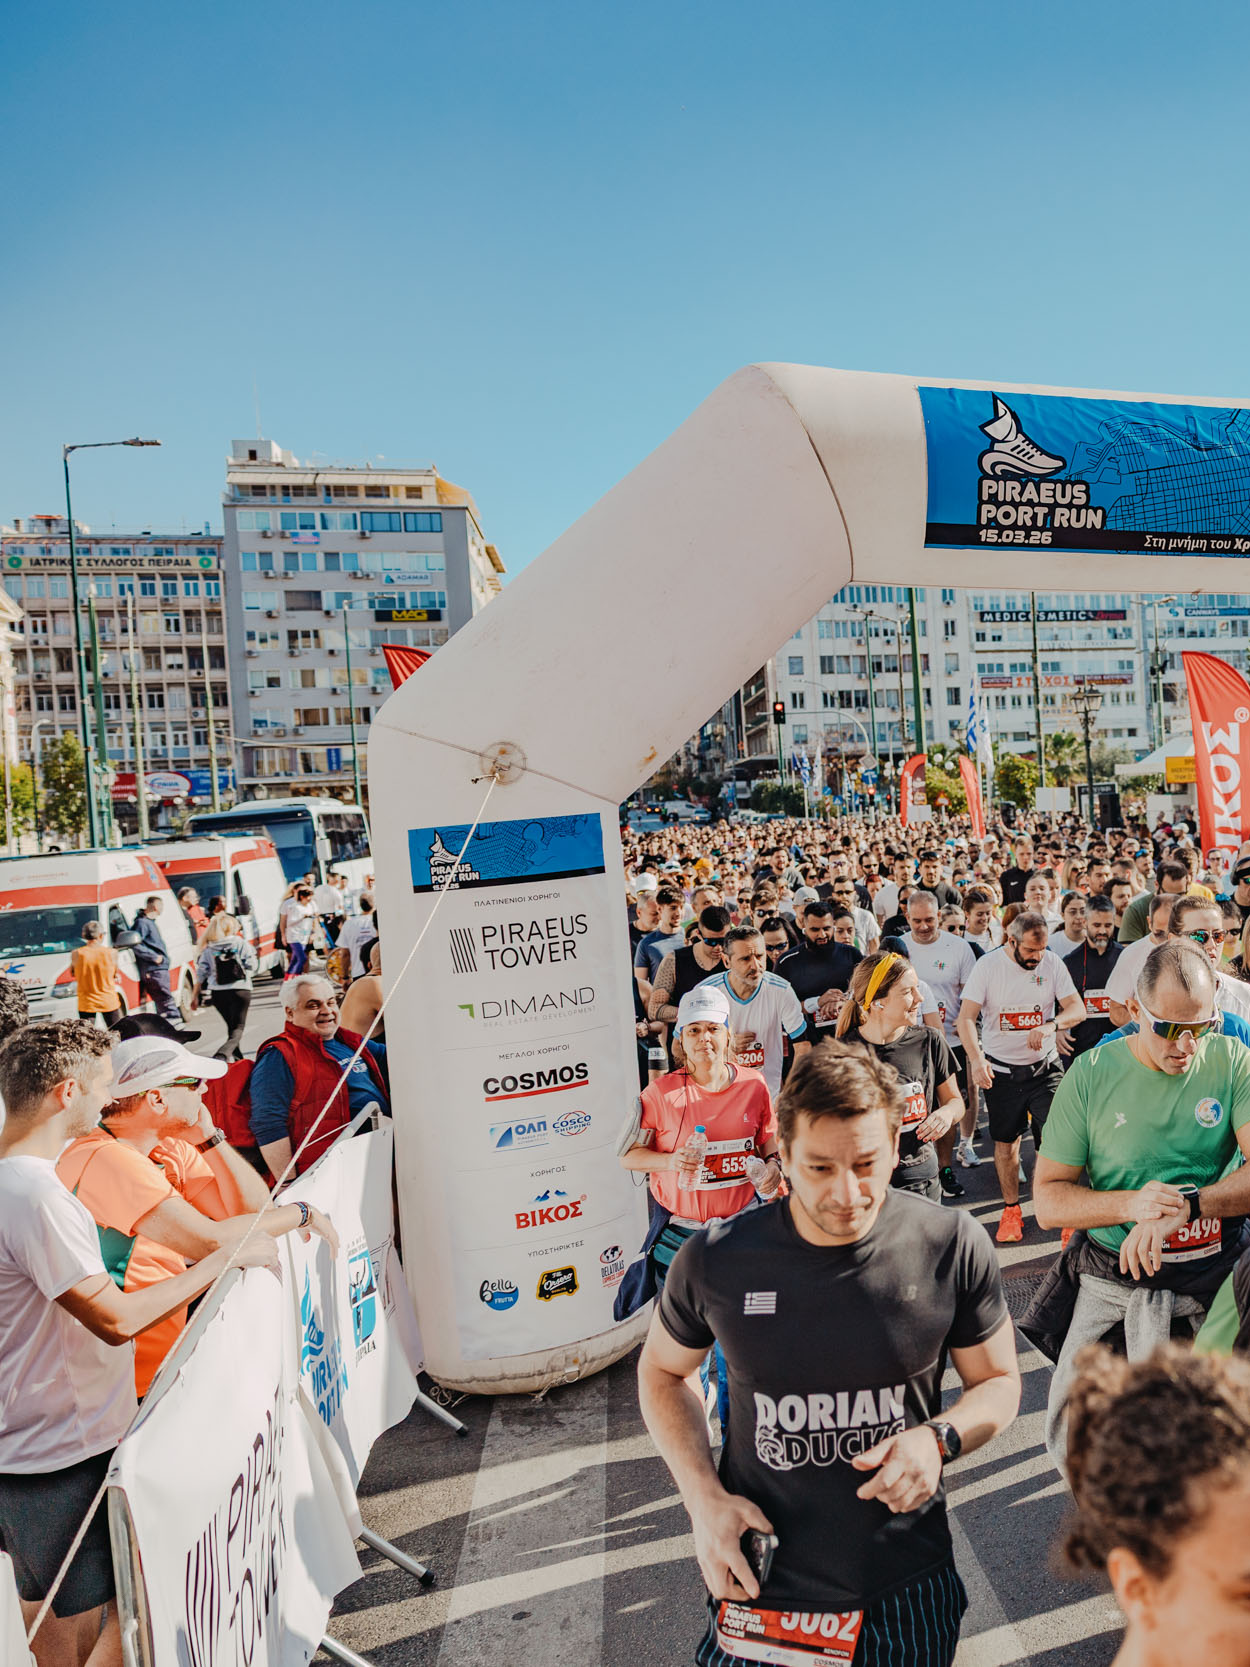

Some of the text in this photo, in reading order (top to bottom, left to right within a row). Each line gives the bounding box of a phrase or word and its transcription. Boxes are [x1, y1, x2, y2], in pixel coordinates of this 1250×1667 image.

[981, 478, 1088, 506] PIRAEUS
[981, 505, 1103, 530] PORT RUN
[979, 529, 1052, 544] 15.03.26
[1144, 535, 1166, 550] Στη
[1168, 535, 1208, 551] μνήμη
[1210, 537, 1232, 550] του
[86, 557, 145, 568] ΣΥΛΛΟΓΟΣ
[148, 557, 192, 568] ΠΕΙΡΑΙΑ
[1015, 675, 1071, 688] ΣΤΧΟΣ
[430, 863, 472, 876] PIRAEUS
[431, 869, 481, 885] PORT RUN
[528, 891, 561, 903] ΧΟΡΗΓΟΙ
[481, 913, 589, 948] PIRAEUS
[484, 939, 578, 971] TOWER
[481, 985, 596, 1020] DIMAND
[1018, 1015, 1042, 1027] 5663
[498, 1043, 571, 1061] ΜΕΓΑΛΟΙ ΧΟΡΗΓΟΙ
[736, 1051, 764, 1066] 5206
[482, 1062, 589, 1096] COSMOS
[514, 1120, 548, 1136] ΟΛΠ
[552, 1114, 592, 1129] COSCO
[554, 1121, 592, 1135] SHIPPING
[530, 1165, 567, 1178] ΧΟΡΗΓΟΣ
[722, 1157, 747, 1174] 553
[514, 1200, 584, 1230] ΒΙΚΟΣ
[1178, 1217, 1221, 1242] 5496
[528, 1239, 585, 1259] ΥΠΟΣΤΗΡΙΚΤΕΣ
[479, 1278, 515, 1303] Bella
[754, 1384, 907, 1433] DORIAN
[724, 1607, 762, 1623] PIRAEUS
[722, 1617, 766, 1635] PORT RUN
[780, 1611, 862, 1642] 5062
[813, 1657, 844, 1667] COSMOS
